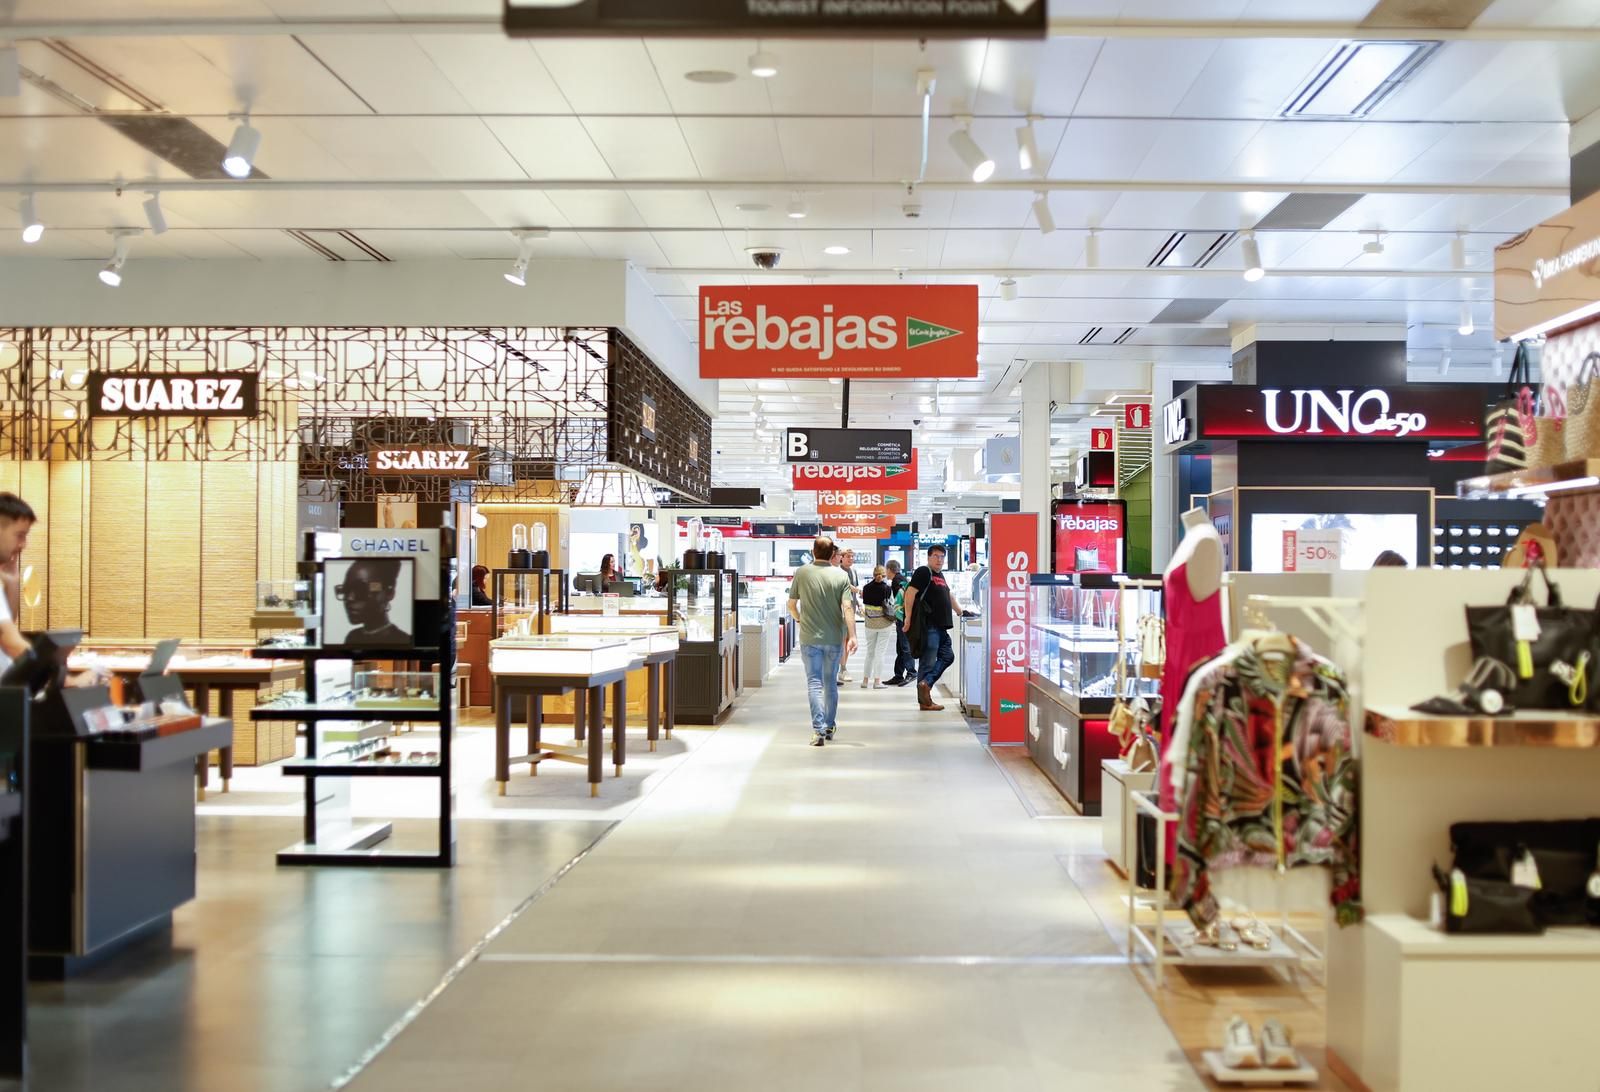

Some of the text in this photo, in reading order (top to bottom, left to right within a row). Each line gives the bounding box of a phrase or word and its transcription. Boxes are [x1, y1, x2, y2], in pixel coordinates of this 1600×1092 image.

[748, 0, 999, 15] TOURIST INFORMATION POINT
[705, 297, 742, 315] Las
[705, 304, 898, 360] rebajas
[101, 378, 243, 411] SUAREZ
[788, 432, 808, 457] B
[376, 451, 469, 470] SUAREZ
[795, 464, 882, 482] rebajas
[818, 490, 882, 508] rebajas
[838, 525, 876, 537] rebajas
[1061, 516, 1118, 533] rebajas
[350, 538, 430, 552] CHANEL
[1299, 546, 1337, 560] -50%
[1000, 550, 1029, 674] rebajas
[994, 649, 1006, 673] Las
